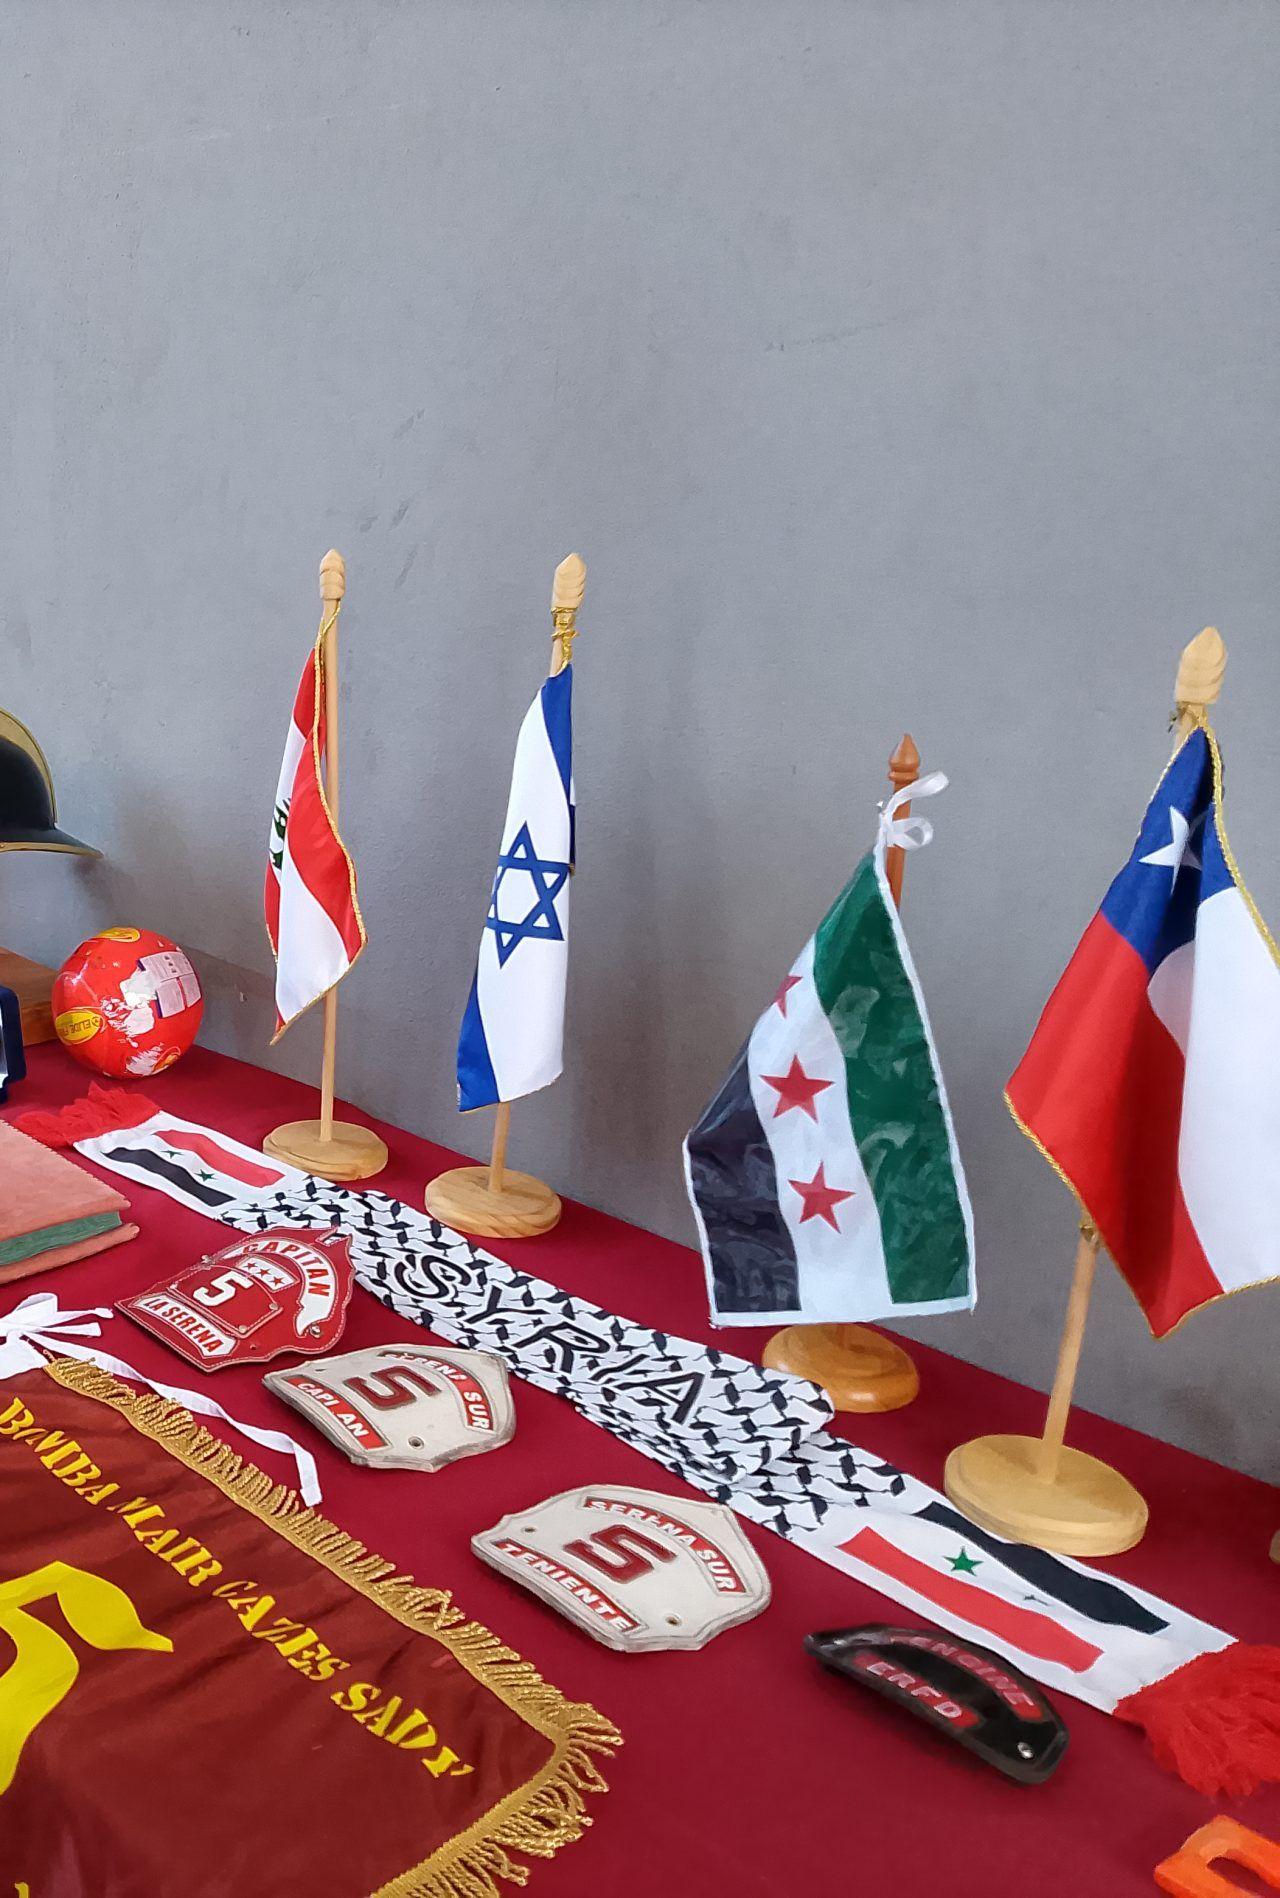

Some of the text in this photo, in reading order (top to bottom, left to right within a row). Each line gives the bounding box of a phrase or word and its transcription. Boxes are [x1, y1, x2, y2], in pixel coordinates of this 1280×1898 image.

[192, 1270, 254, 1307] 5
[241, 1240, 331, 1298] CAPITAN
[142, 1297, 224, 1354] LA SERENA
[394, 1252, 705, 1426] SYRIA
[342, 1365, 442, 1412] 5
[463, 1391, 490, 1429] SUR
[562, 1523, 679, 1584] 5
[696, 1549, 738, 1593] SUR
[496, 1541, 634, 1631] TENIENTE
[106, 1496, 224, 1588] MAIR
[212, 1580, 352, 1682] CAZES
[330, 1682, 476, 1778] SADY
[866, 1661, 964, 1719] ERFD
